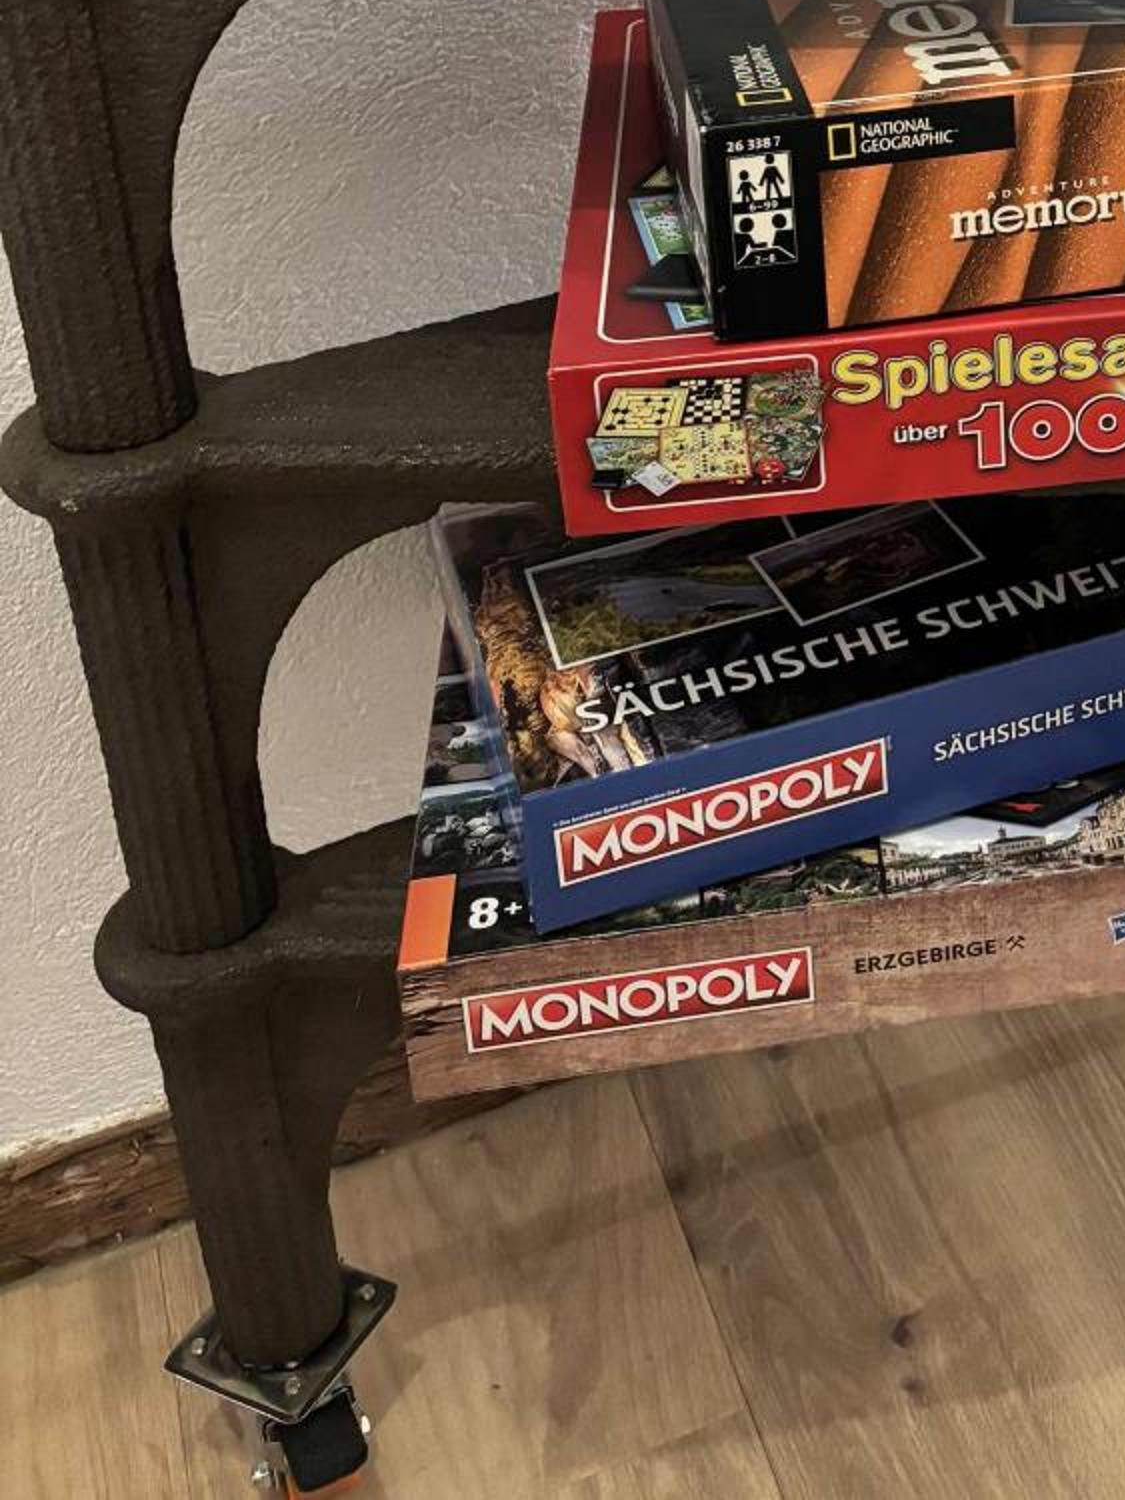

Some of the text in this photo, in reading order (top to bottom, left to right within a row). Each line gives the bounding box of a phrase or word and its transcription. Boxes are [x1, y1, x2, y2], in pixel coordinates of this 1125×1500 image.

[860, 117, 934, 139] NATIONAL
[860, 128, 955, 154] GEOGRAPHIC
[725, 139, 745, 153] 26
[986, 175, 1110, 201] ADVENTURE
[892, 422, 948, 445] über
[574, 615, 910, 734] SÄCHSISCHE
[933, 703, 1076, 763] SÄCHSISCHE
[570, 750, 877, 874] MONOPOLY
[467, 896, 523, 930] 8+
[854, 937, 997, 975] ERZGEBIRGE
[480, 956, 803, 1041] MONOPOLY
